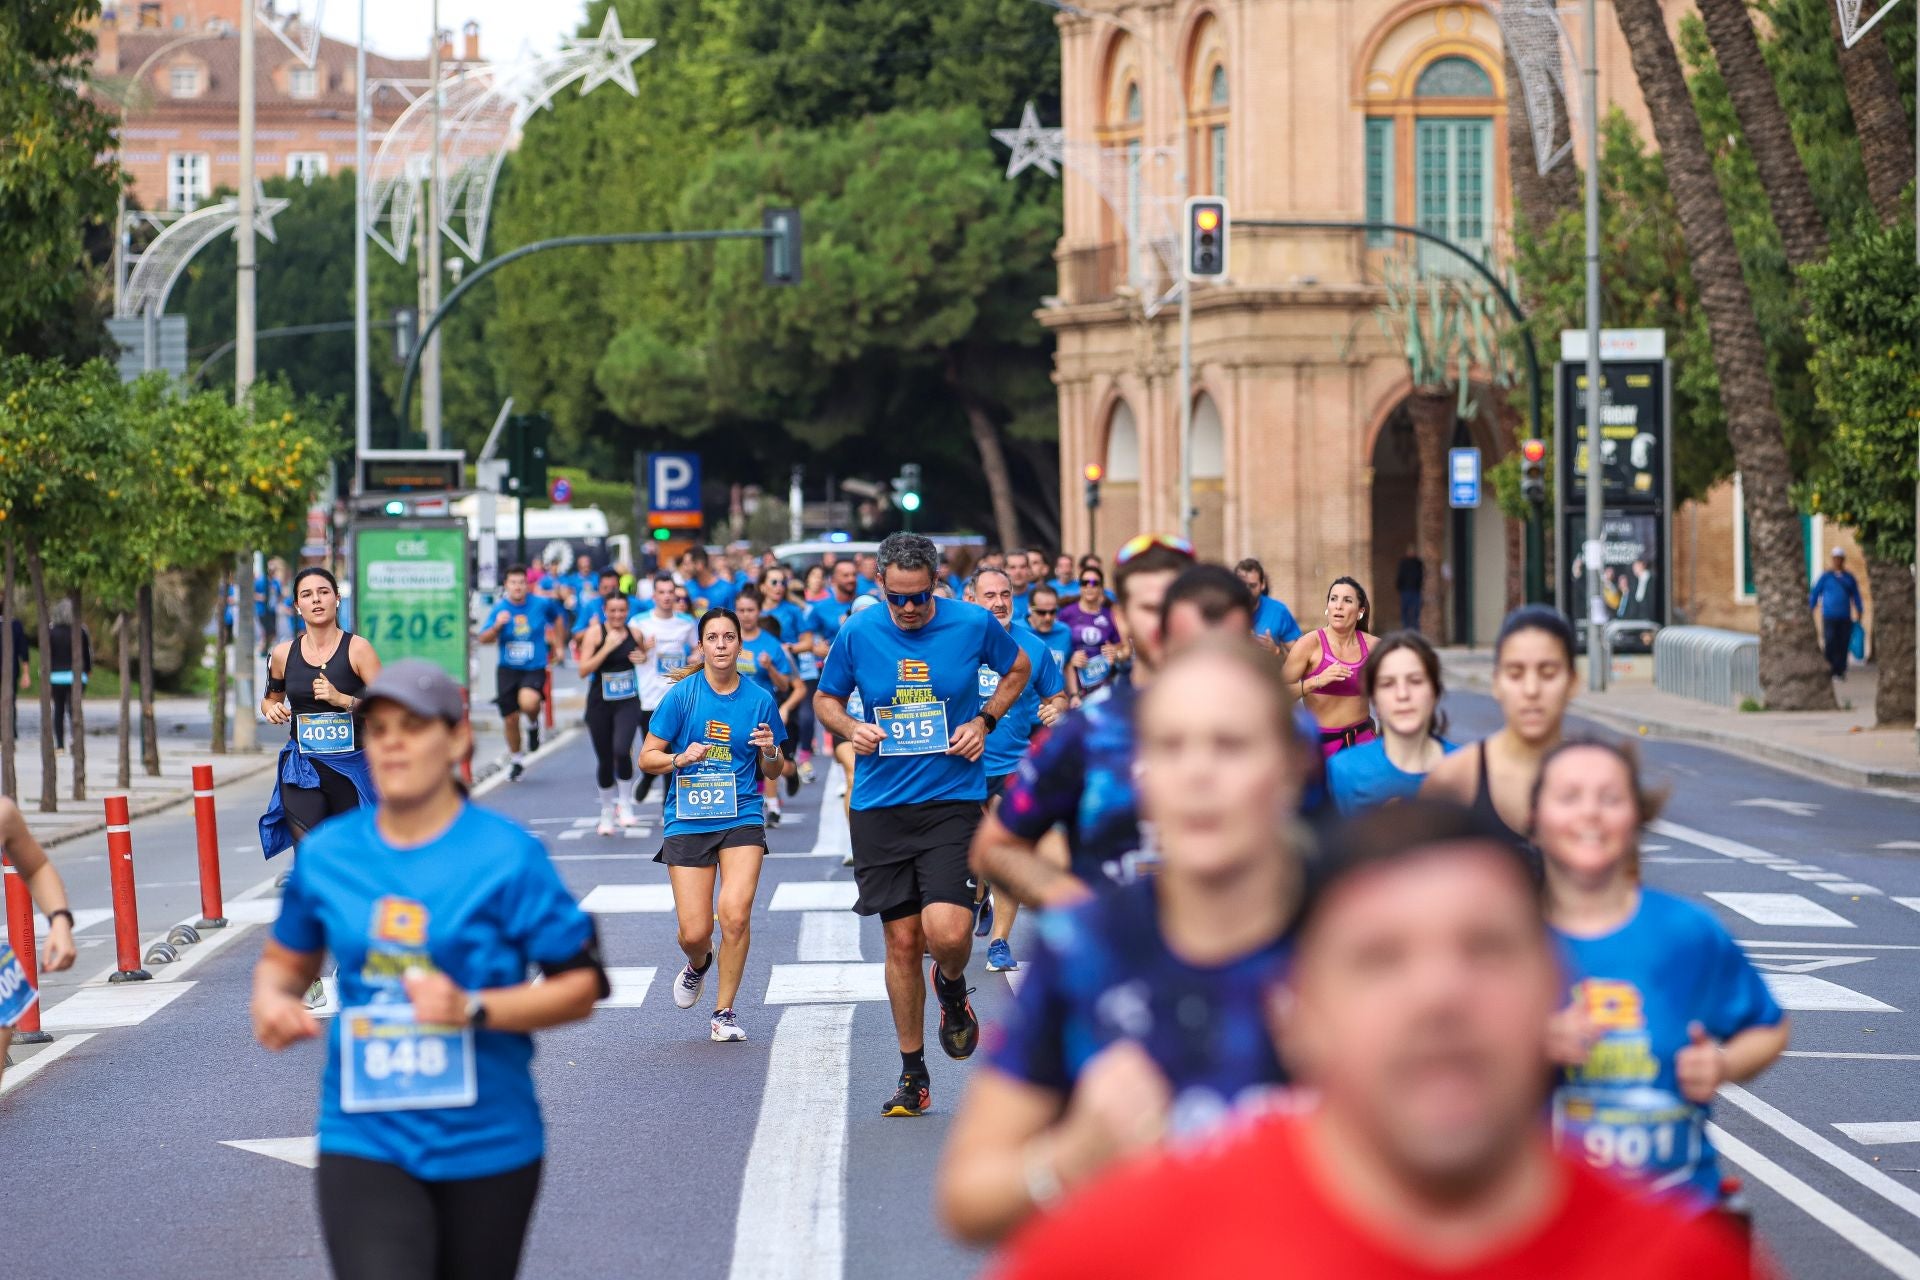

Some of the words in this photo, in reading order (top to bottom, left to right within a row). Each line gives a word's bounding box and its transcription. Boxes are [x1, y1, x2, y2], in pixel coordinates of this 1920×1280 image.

[655, 457, 693, 510] P
[365, 612, 454, 641] 120€
[302, 725, 349, 741] 4039
[891, 720, 934, 739] 915
[688, 789, 725, 805] 692
[364, 1036, 448, 1080] 848
[1584, 1122, 1675, 1169] 901
